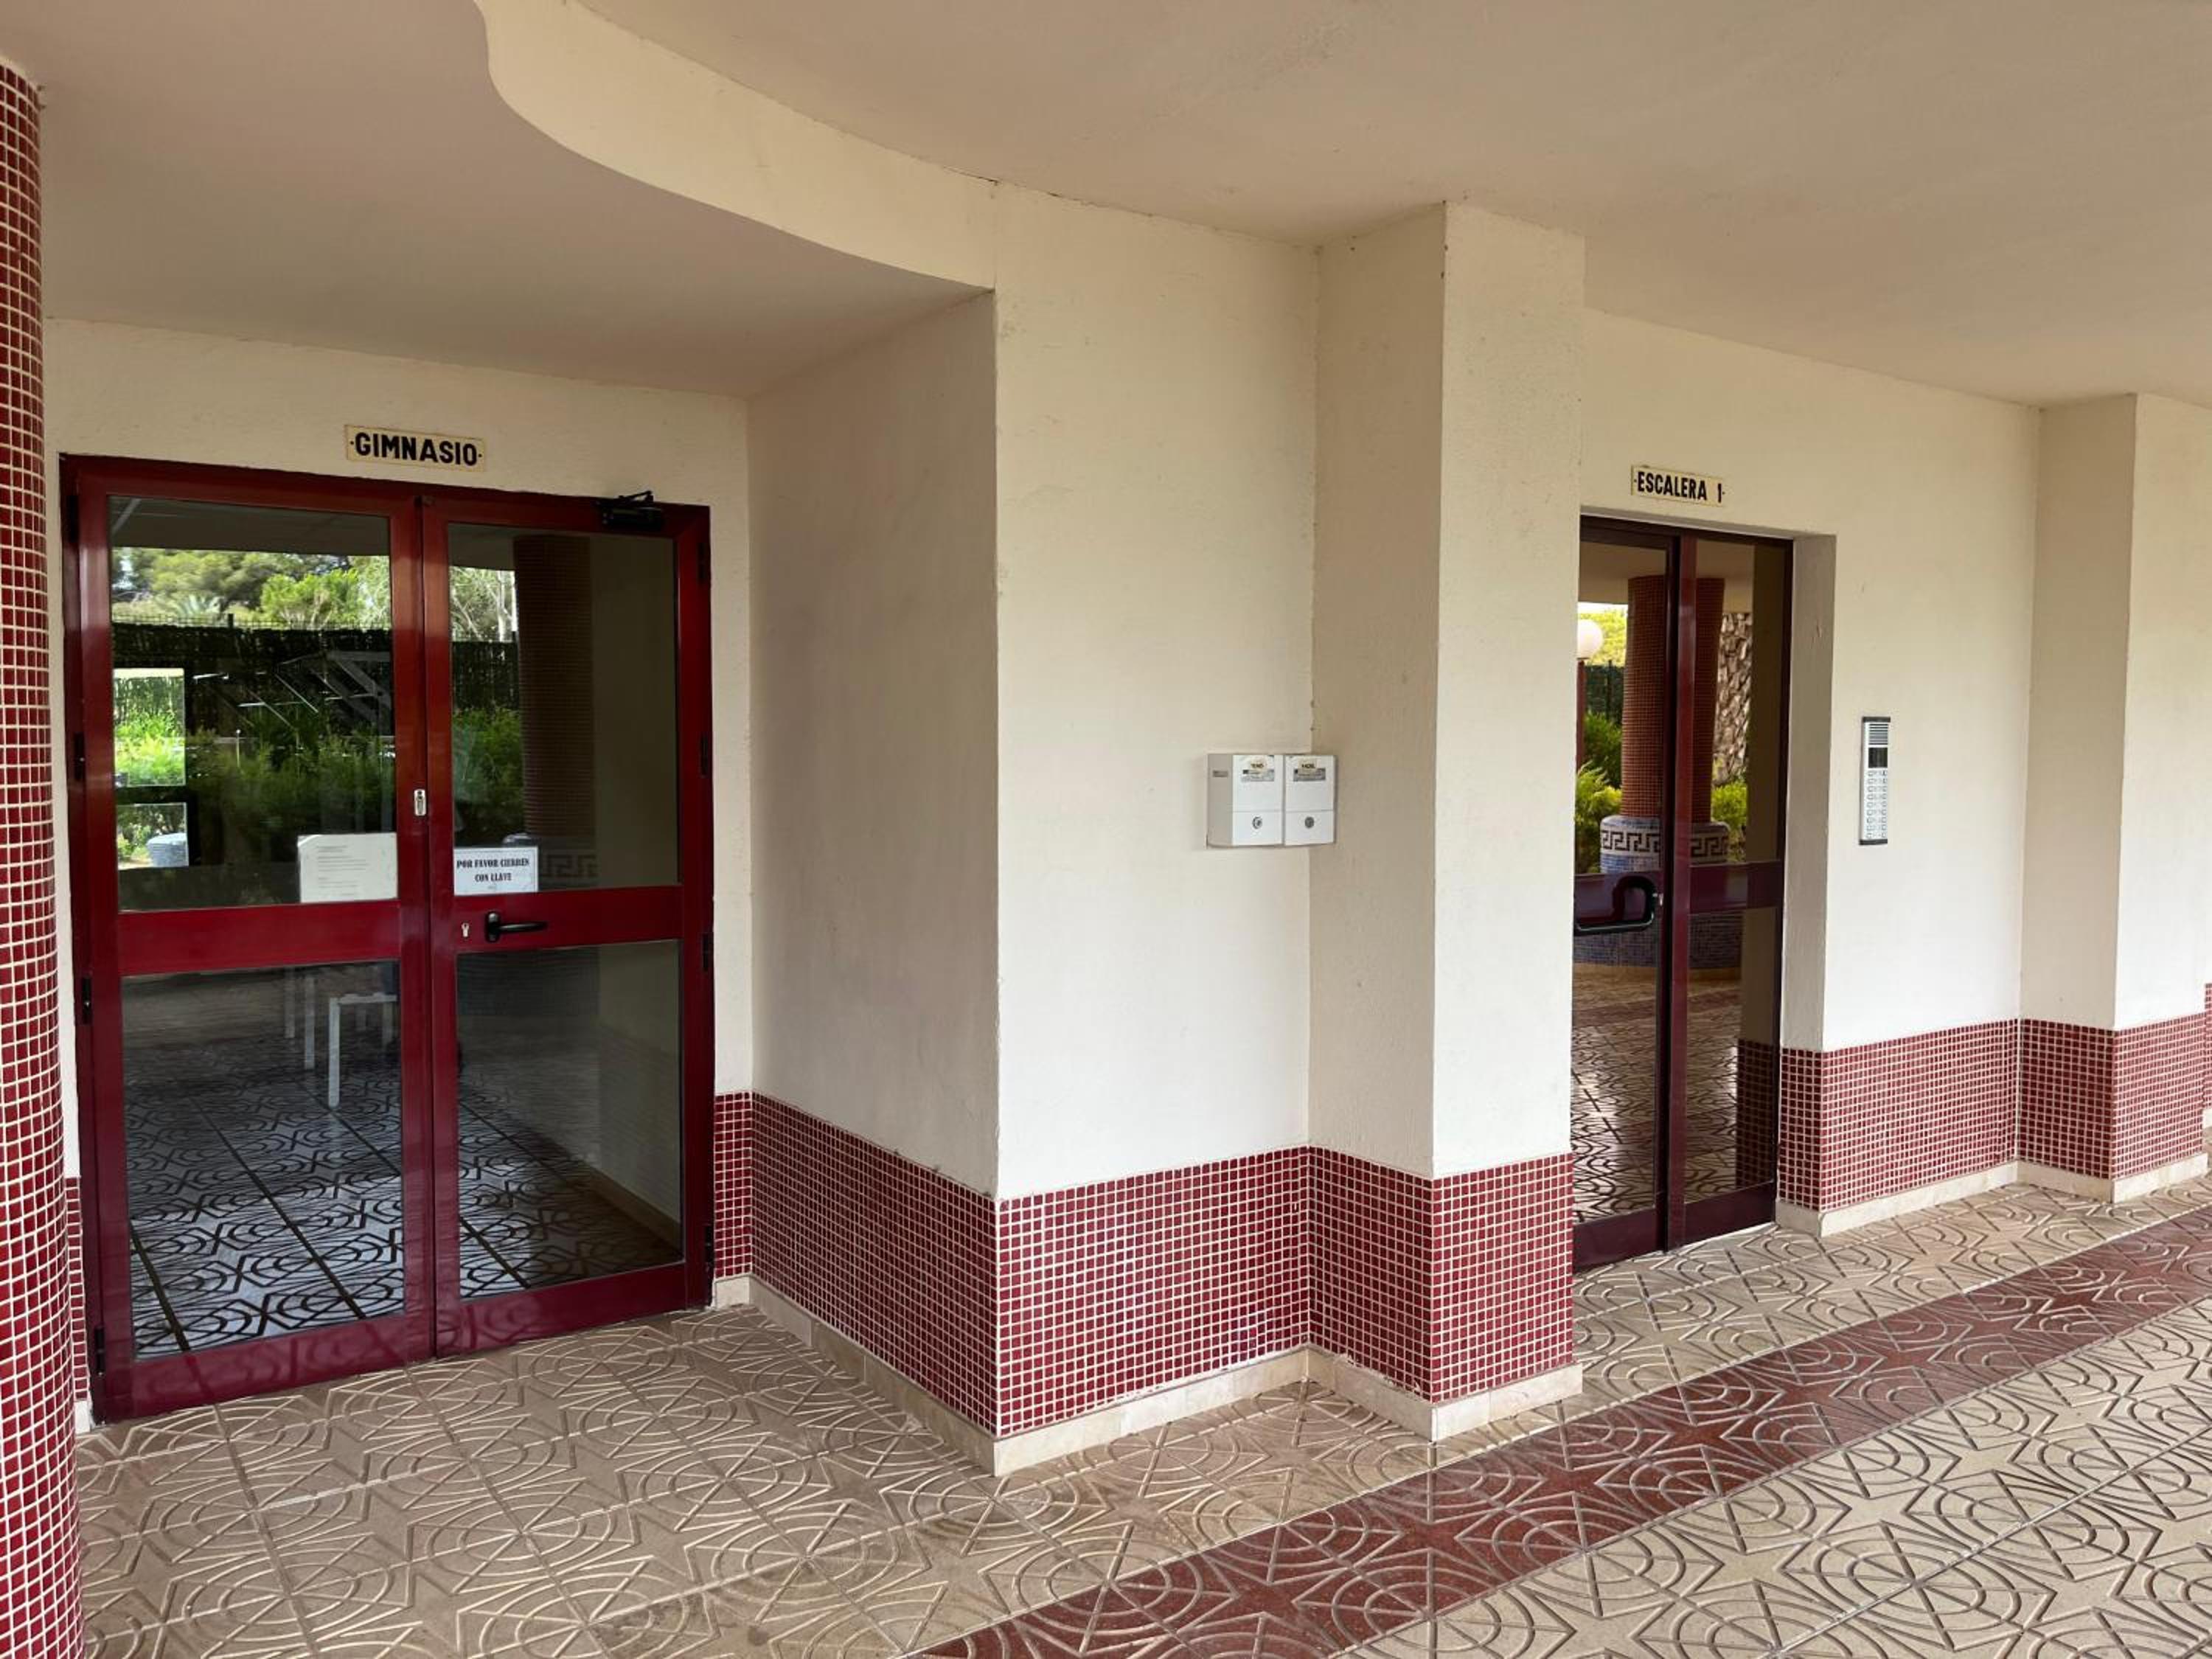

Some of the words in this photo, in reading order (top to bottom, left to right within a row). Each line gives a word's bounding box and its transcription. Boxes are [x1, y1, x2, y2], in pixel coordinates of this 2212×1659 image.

[355, 432, 478, 466] GIMNASIO
[1637, 471, 1708, 501] ESCALERA
[456, 859, 473, 869] POR
[474, 858, 499, 868] FAVOR
[474, 874, 489, 883] CON
[490, 872, 512, 882] LLAVE
